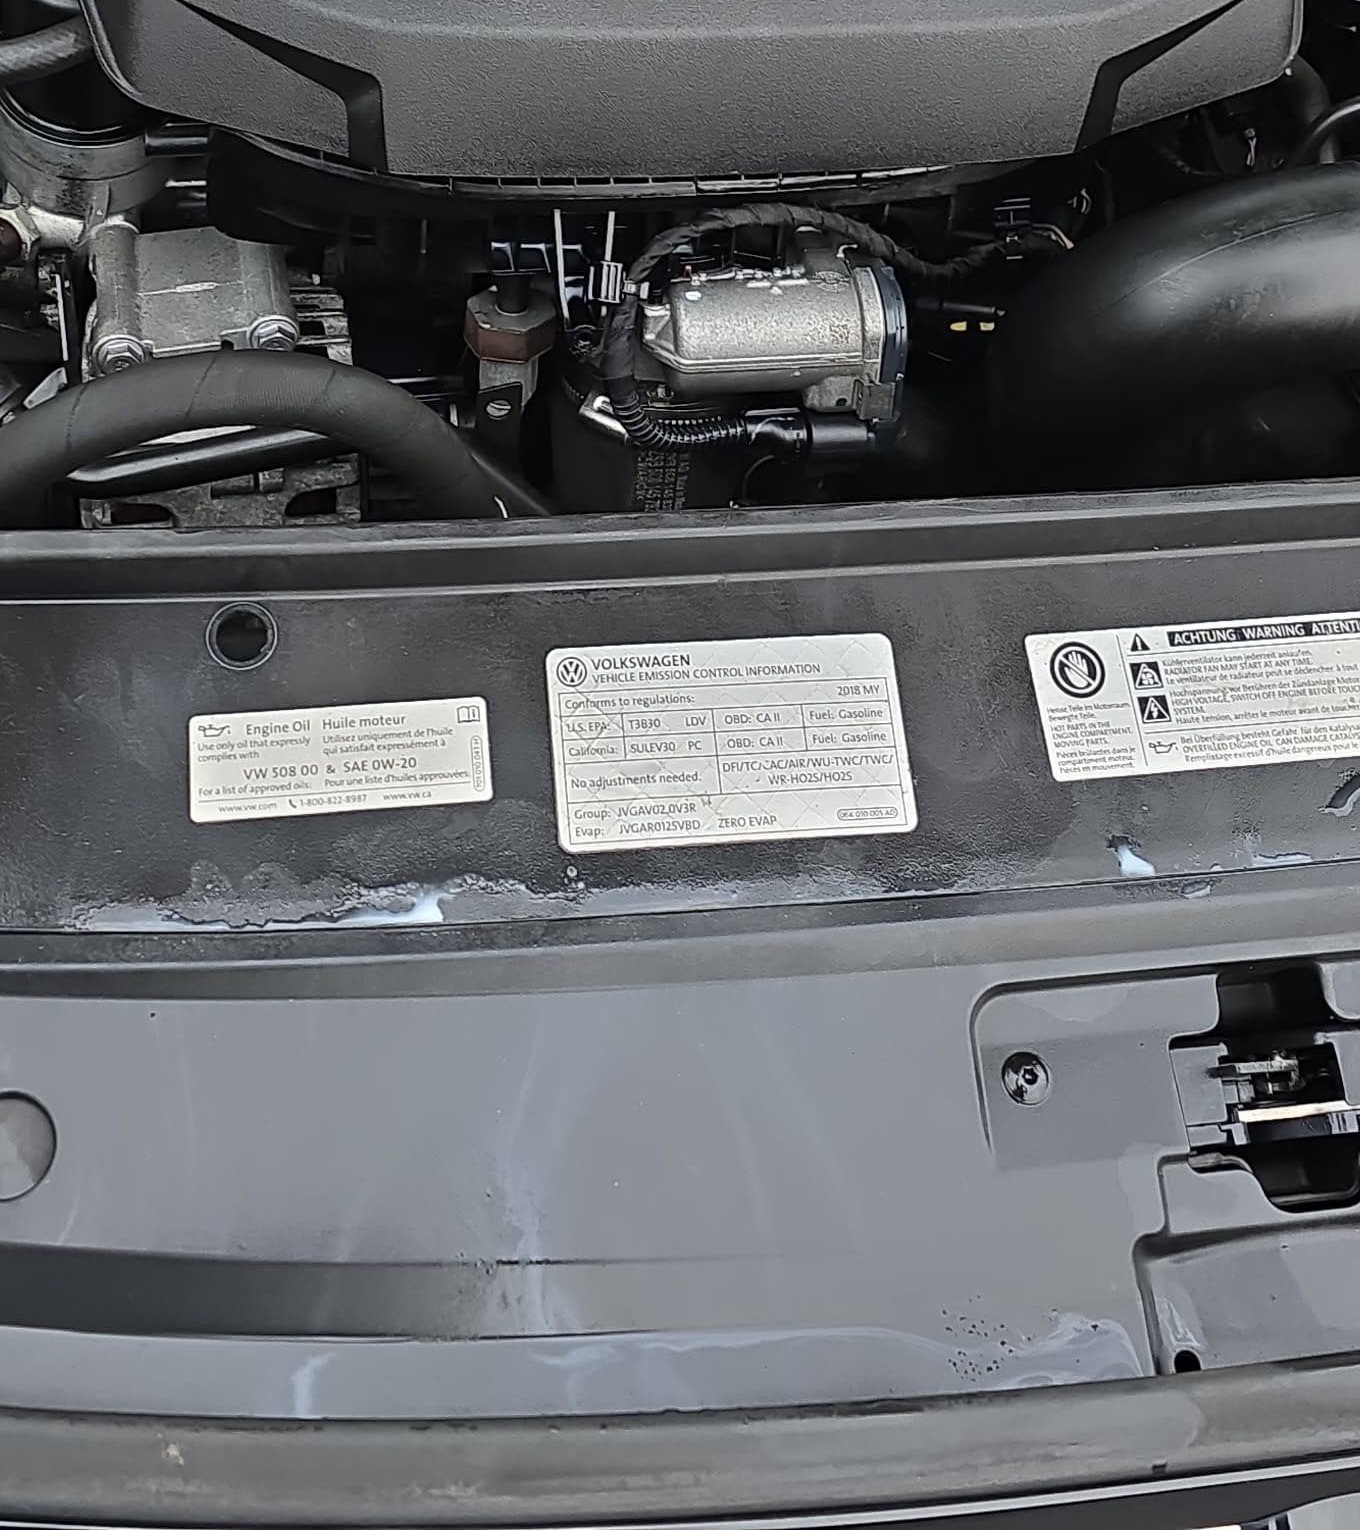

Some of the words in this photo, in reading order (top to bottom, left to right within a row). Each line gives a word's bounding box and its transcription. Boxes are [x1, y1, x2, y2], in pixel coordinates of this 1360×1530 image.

[1172, 629, 1236, 644] ACHTUNG
[1241, 624, 1305, 639] WARNING
[591, 654, 690, 670] VOLKSWAGEN
[1163, 666, 1201, 675] RADIATOR
[1274, 659, 1292, 667] ANY
[592, 673, 635, 684] VEHICLE
[638, 670, 690, 681] EMISSION
[693, 667, 743, 678] CONTROL
[745, 663, 820, 676] INFORMATION
[837, 685, 860, 695] 2018
[862, 684, 880, 694] MY
[1171, 698, 1192, 706] HIGH
[1230, 692, 1261, 701] SWITCH
[1277, 689, 1306, 697] ENGINE
[1307, 686, 1337, 695] BEFORE
[564, 697, 616, 709] Conforms
[618, 697, 629, 706] to
[632, 693, 694, 707] regulations:
[724, 714, 751, 724] OBD:
[756, 713, 770, 722] CA
[773, 713, 780, 721] II
[809, 710, 834, 720] Fuel:
[838, 706, 883, 719] Gasoline
[246, 721, 289, 738] Engine
[292, 720, 310, 731] Oil
[322, 717, 355, 729] Huile
[359, 714, 405, 726] moteur
[588, 721, 610, 731] EPA:
[684, 716, 706, 726] LDV
[323, 734, 354, 743] Utilisez
[357, 730, 412, 743] uniquement
[414, 729, 424, 737] de
[426, 727, 453, 736] l'huile
[726, 737, 754, 748] OBD:
[759, 736, 773, 746] CA
[776, 736, 783, 745] II
[812, 733, 837, 744] Fuel:
[841, 729, 886, 743] Gasoline
[197, 742, 213, 751] Use
[215, 741, 234, 752] only
[249, 739, 267, 747] that
[269, 736, 310, 748] expressly
[322, 746, 337, 756] qui
[340, 743, 374, 752] satisfait
[377, 739, 438, 751] expressément
[568, 744, 617, 756] California:
[630, 741, 675, 753] SULEV30
[688, 740, 702, 750] PC
[1182, 742, 1228, 753] OVERFILLED
[1229, 740, 1258, 749] ENGINE
[1275, 737, 1292, 745] CAN
[1293, 734, 1328, 744] DAMAGE
[198, 752, 236, 763] complies
[239, 750, 259, 759] with
[243, 767, 268, 779] VW
[272, 765, 296, 777] 508
[300, 764, 318, 775] 00
[326, 765, 335, 773] &
[343, 760, 368, 772] SAE
[372, 756, 417, 770] 0W-20
[199, 787, 212, 795] For
[223, 786, 235, 794] list
[237, 785, 247, 793] of
[250, 781, 291, 795] approved
[293, 780, 311, 789] oils:
[571, 778, 585, 788] No
[588, 774, 657, 789] adjustments
[658, 771, 701, 783] needed.
[300, 794, 366, 806] 1-800-822-8987
[383, 790, 431, 800] www.vw.ca
[219, 802, 276, 812] www.vw.com
[574, 808, 611, 821] Group:
[575, 825, 604, 838] Evap:
[718, 817, 746, 827] ZERO
[749, 815, 777, 826] EVAP
